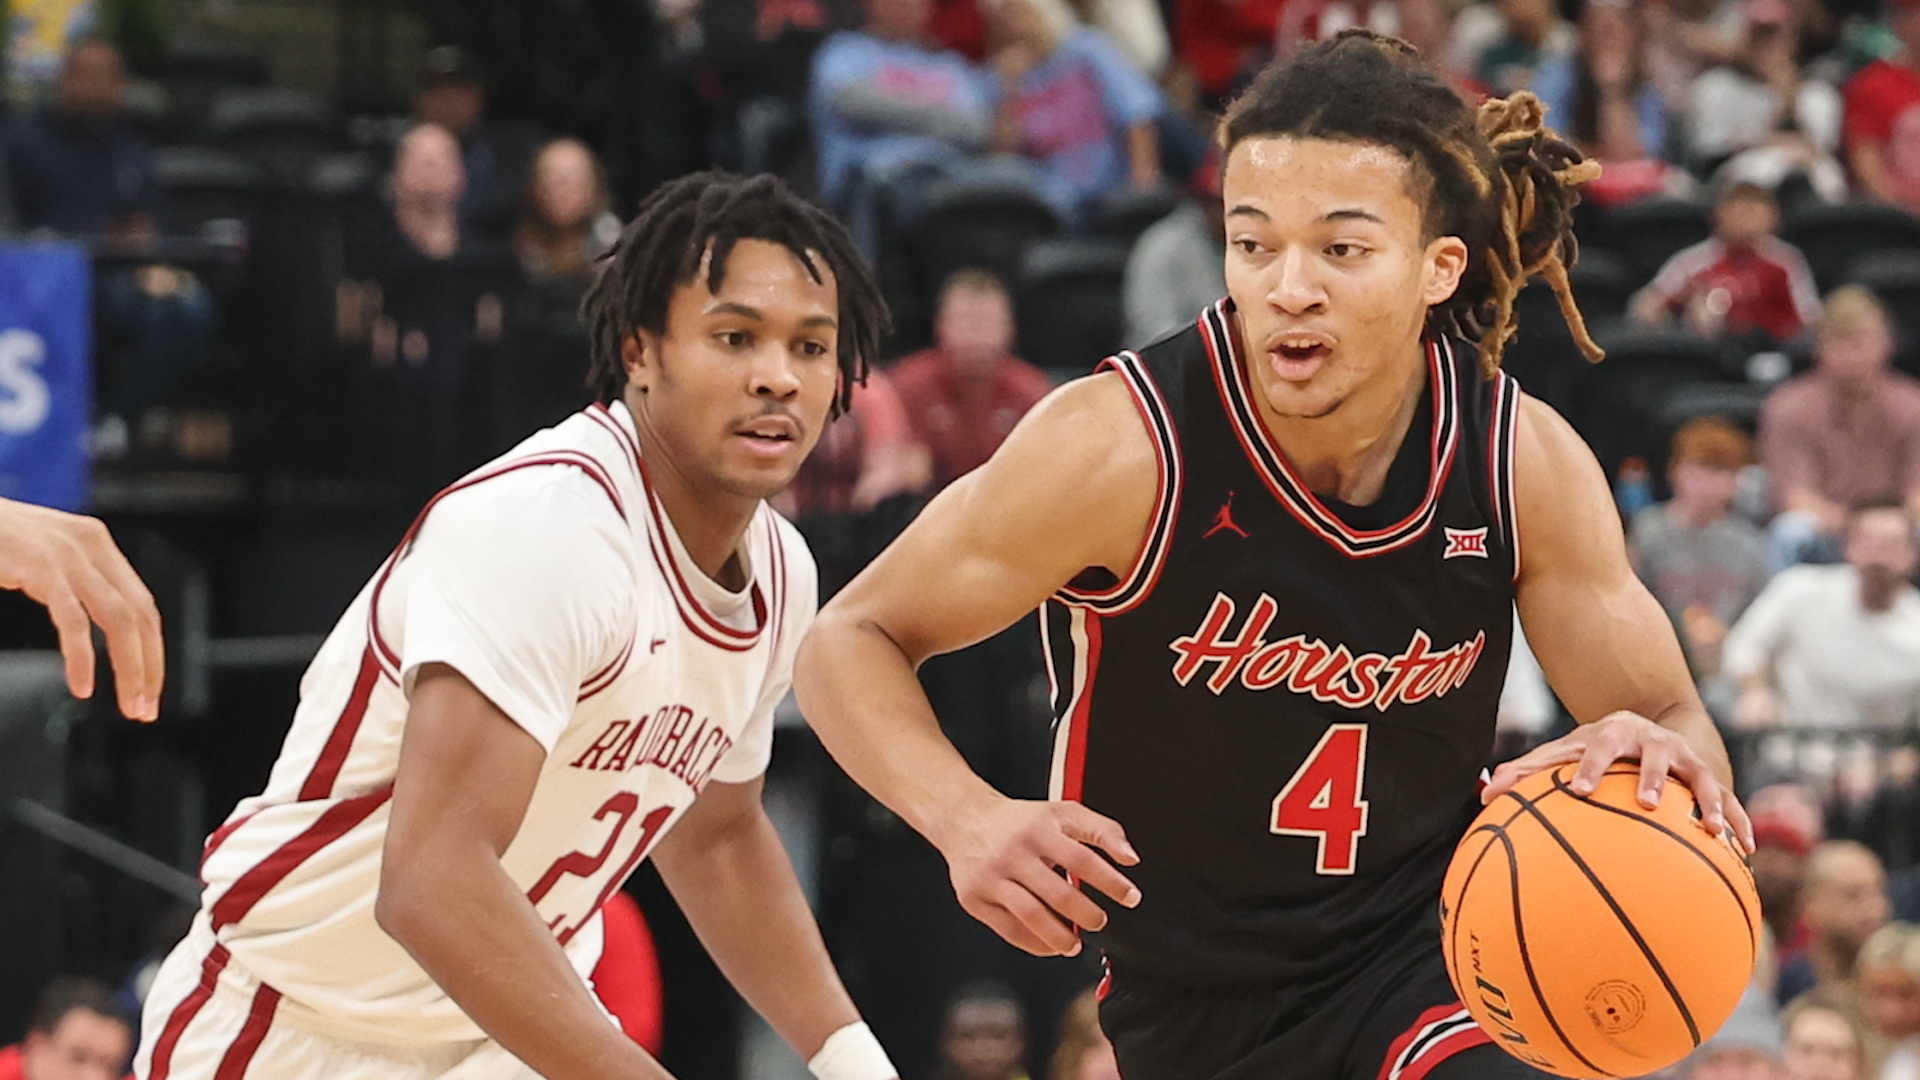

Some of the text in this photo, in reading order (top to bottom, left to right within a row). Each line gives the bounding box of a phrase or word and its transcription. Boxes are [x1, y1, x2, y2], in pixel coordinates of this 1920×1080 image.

[1448, 532, 1486, 555] XII
[1169, 591, 1486, 712] Houston
[1269, 723, 1369, 875] 4
[527, 791, 675, 946] 21
[1470, 929, 1483, 974] NXT
